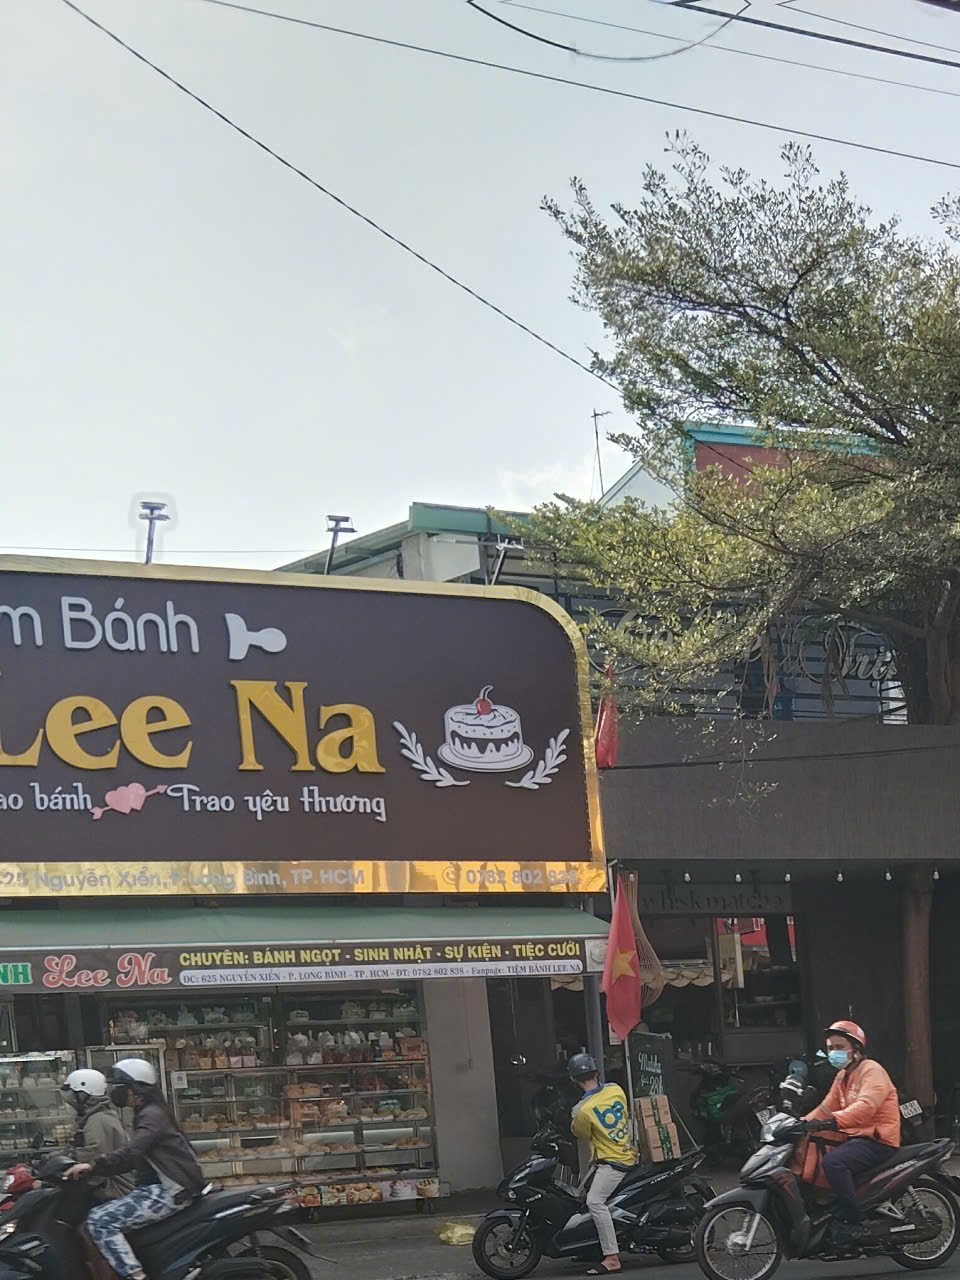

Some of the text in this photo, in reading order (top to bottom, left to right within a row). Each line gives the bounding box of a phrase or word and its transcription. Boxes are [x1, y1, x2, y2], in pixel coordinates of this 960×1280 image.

[61, 596, 200, 653] Bánh
[230, 680, 386, 773] Na
[30, 783, 92, 811] bánh
[165, 784, 235, 813] Trao
[244, 790, 290, 820] yêu
[300, 786, 387, 823] thương
[35, 867, 112, 891] Nguyễn
[511, 869, 543, 885] 802
[179, 940, 580, 966] CHUYÊN: BÁNH NGỌT SINH NHẬT SỰ KIỆN TIỆC CƯỚI
[43, 954, 111, 988] Lee
[116, 952, 173, 988] Na
[201, 974, 217, 984] 625
[299, 971, 323, 981] LONG
[354, 970, 368, 979] TP.
[370, 969, 389, 978] HCM
[412, 968, 432, 976] 0782
[433, 967, 448, 976] 802
[450, 967, 464, 975] 838
[471, 966, 504, 977] Fanpage:
[552, 964, 568, 973] LEE
[568, 964, 581, 973] NA
